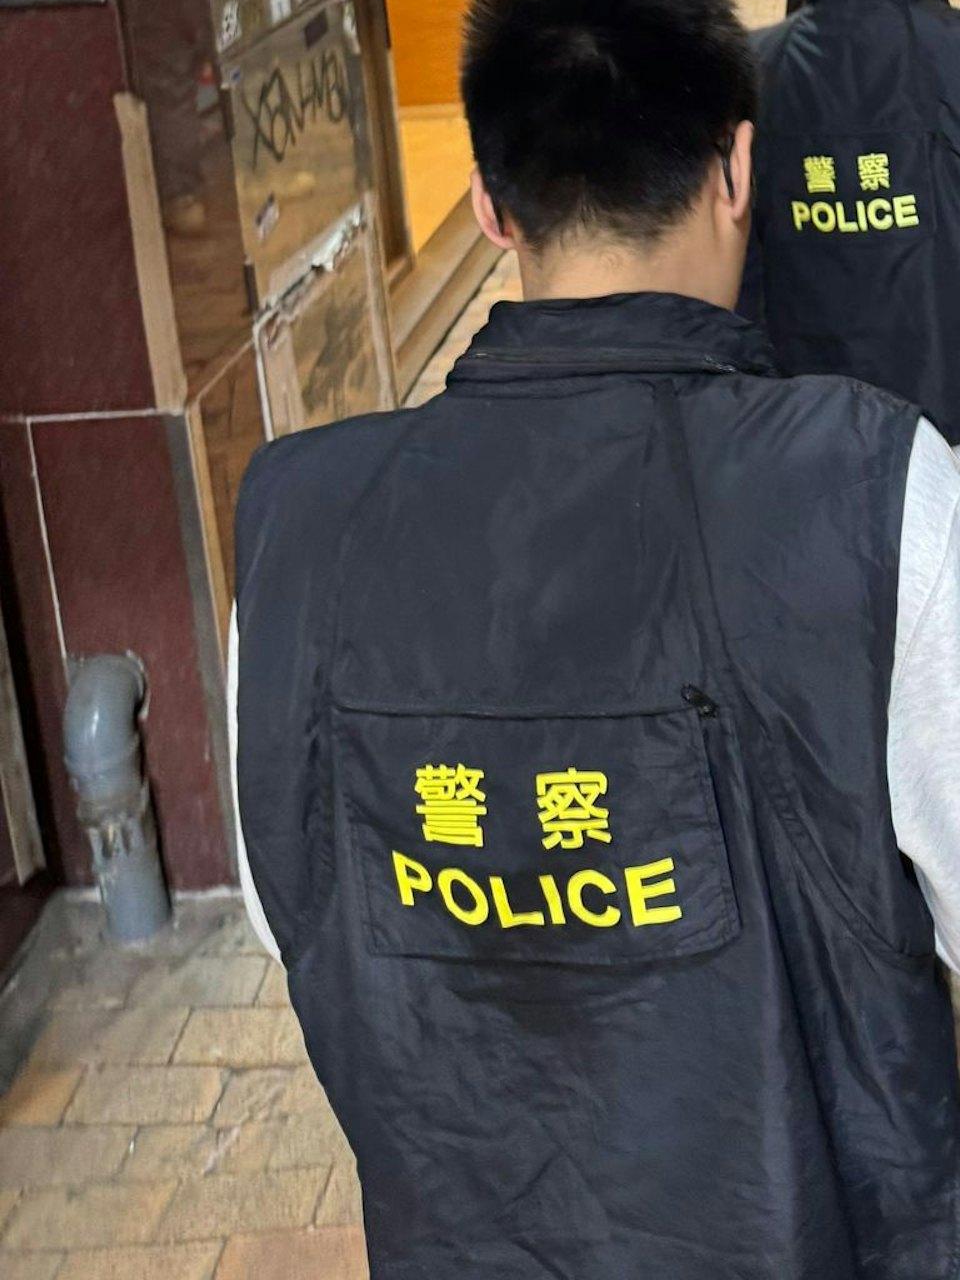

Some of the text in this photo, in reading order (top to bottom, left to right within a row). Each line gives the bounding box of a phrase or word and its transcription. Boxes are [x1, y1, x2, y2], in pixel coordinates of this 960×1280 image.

[803, 153, 890, 193] 警察
[791, 194, 920, 233] POLICE
[415, 763, 612, 850] 警察
[391, 849, 683, 929] POLICE
